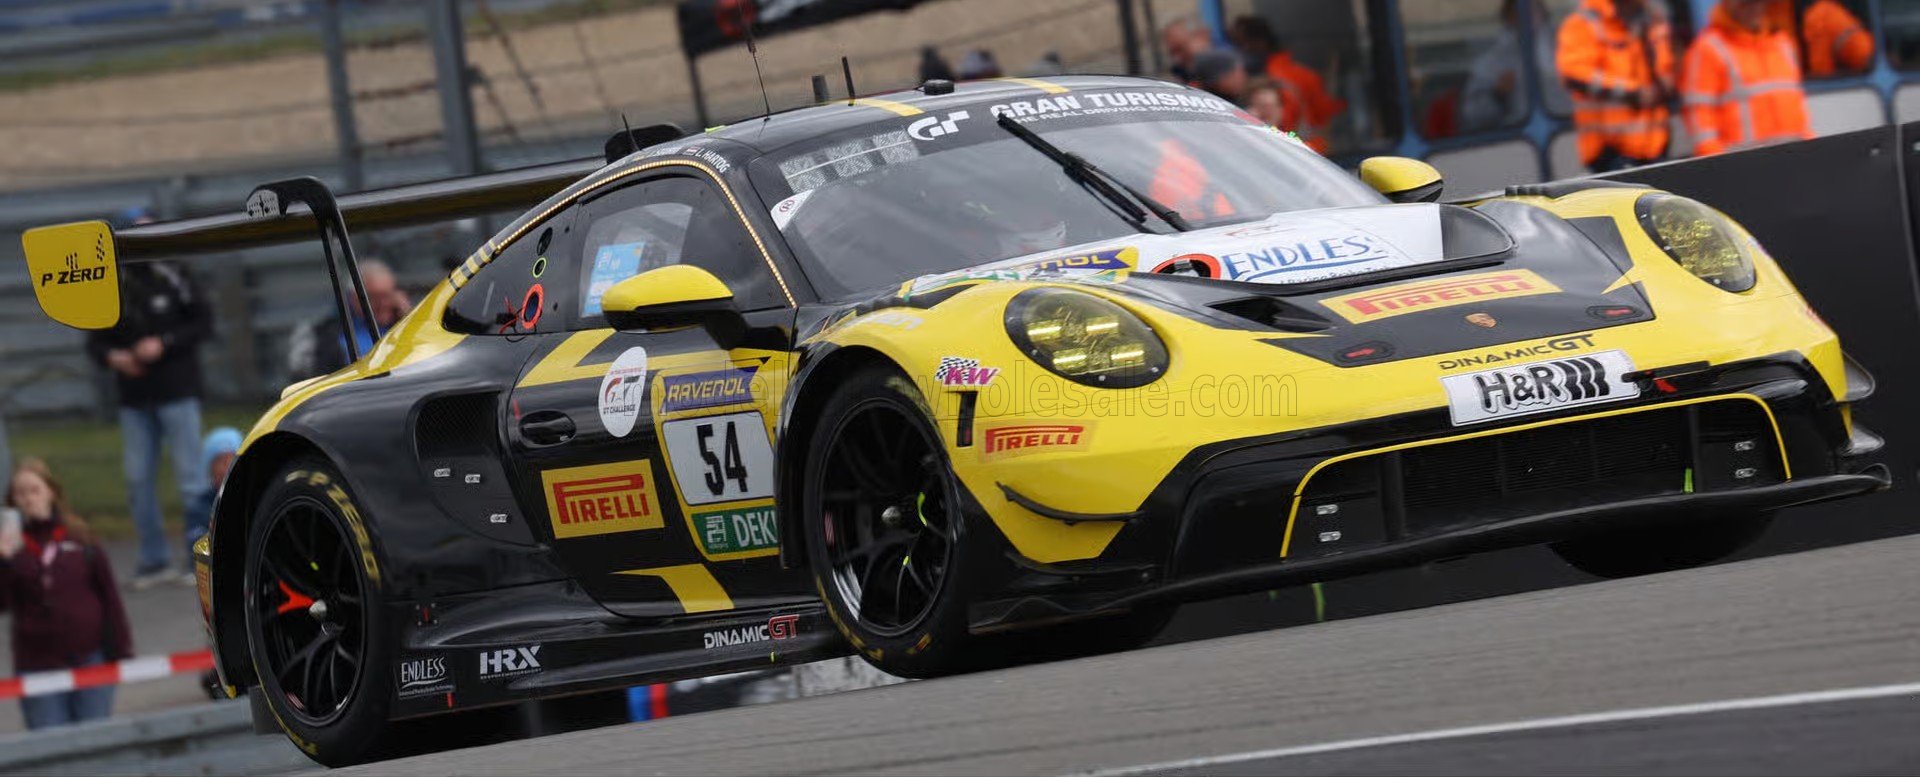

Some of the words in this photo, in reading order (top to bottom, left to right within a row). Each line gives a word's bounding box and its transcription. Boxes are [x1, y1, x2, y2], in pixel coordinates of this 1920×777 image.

[990, 95, 1082, 118] GRAN
[1084, 92, 1227, 111] TURISMO
[41, 273, 54, 287] P
[57, 266, 105, 284] ZERO
[1346, 274, 1535, 316] PIRELLI
[667, 377, 746, 403] RAVENOL
[944, 366, 998, 385] KW
[1473, 365, 1562, 409] H&R
[985, 425, 1084, 454] PIRELLI
[696, 421, 749, 496] 54
[553, 473, 651, 525] PIRELLI
[732, 510, 777, 548] DEK
[401, 656, 446, 683] ENDLESS
[479, 645, 541, 675] HRX
